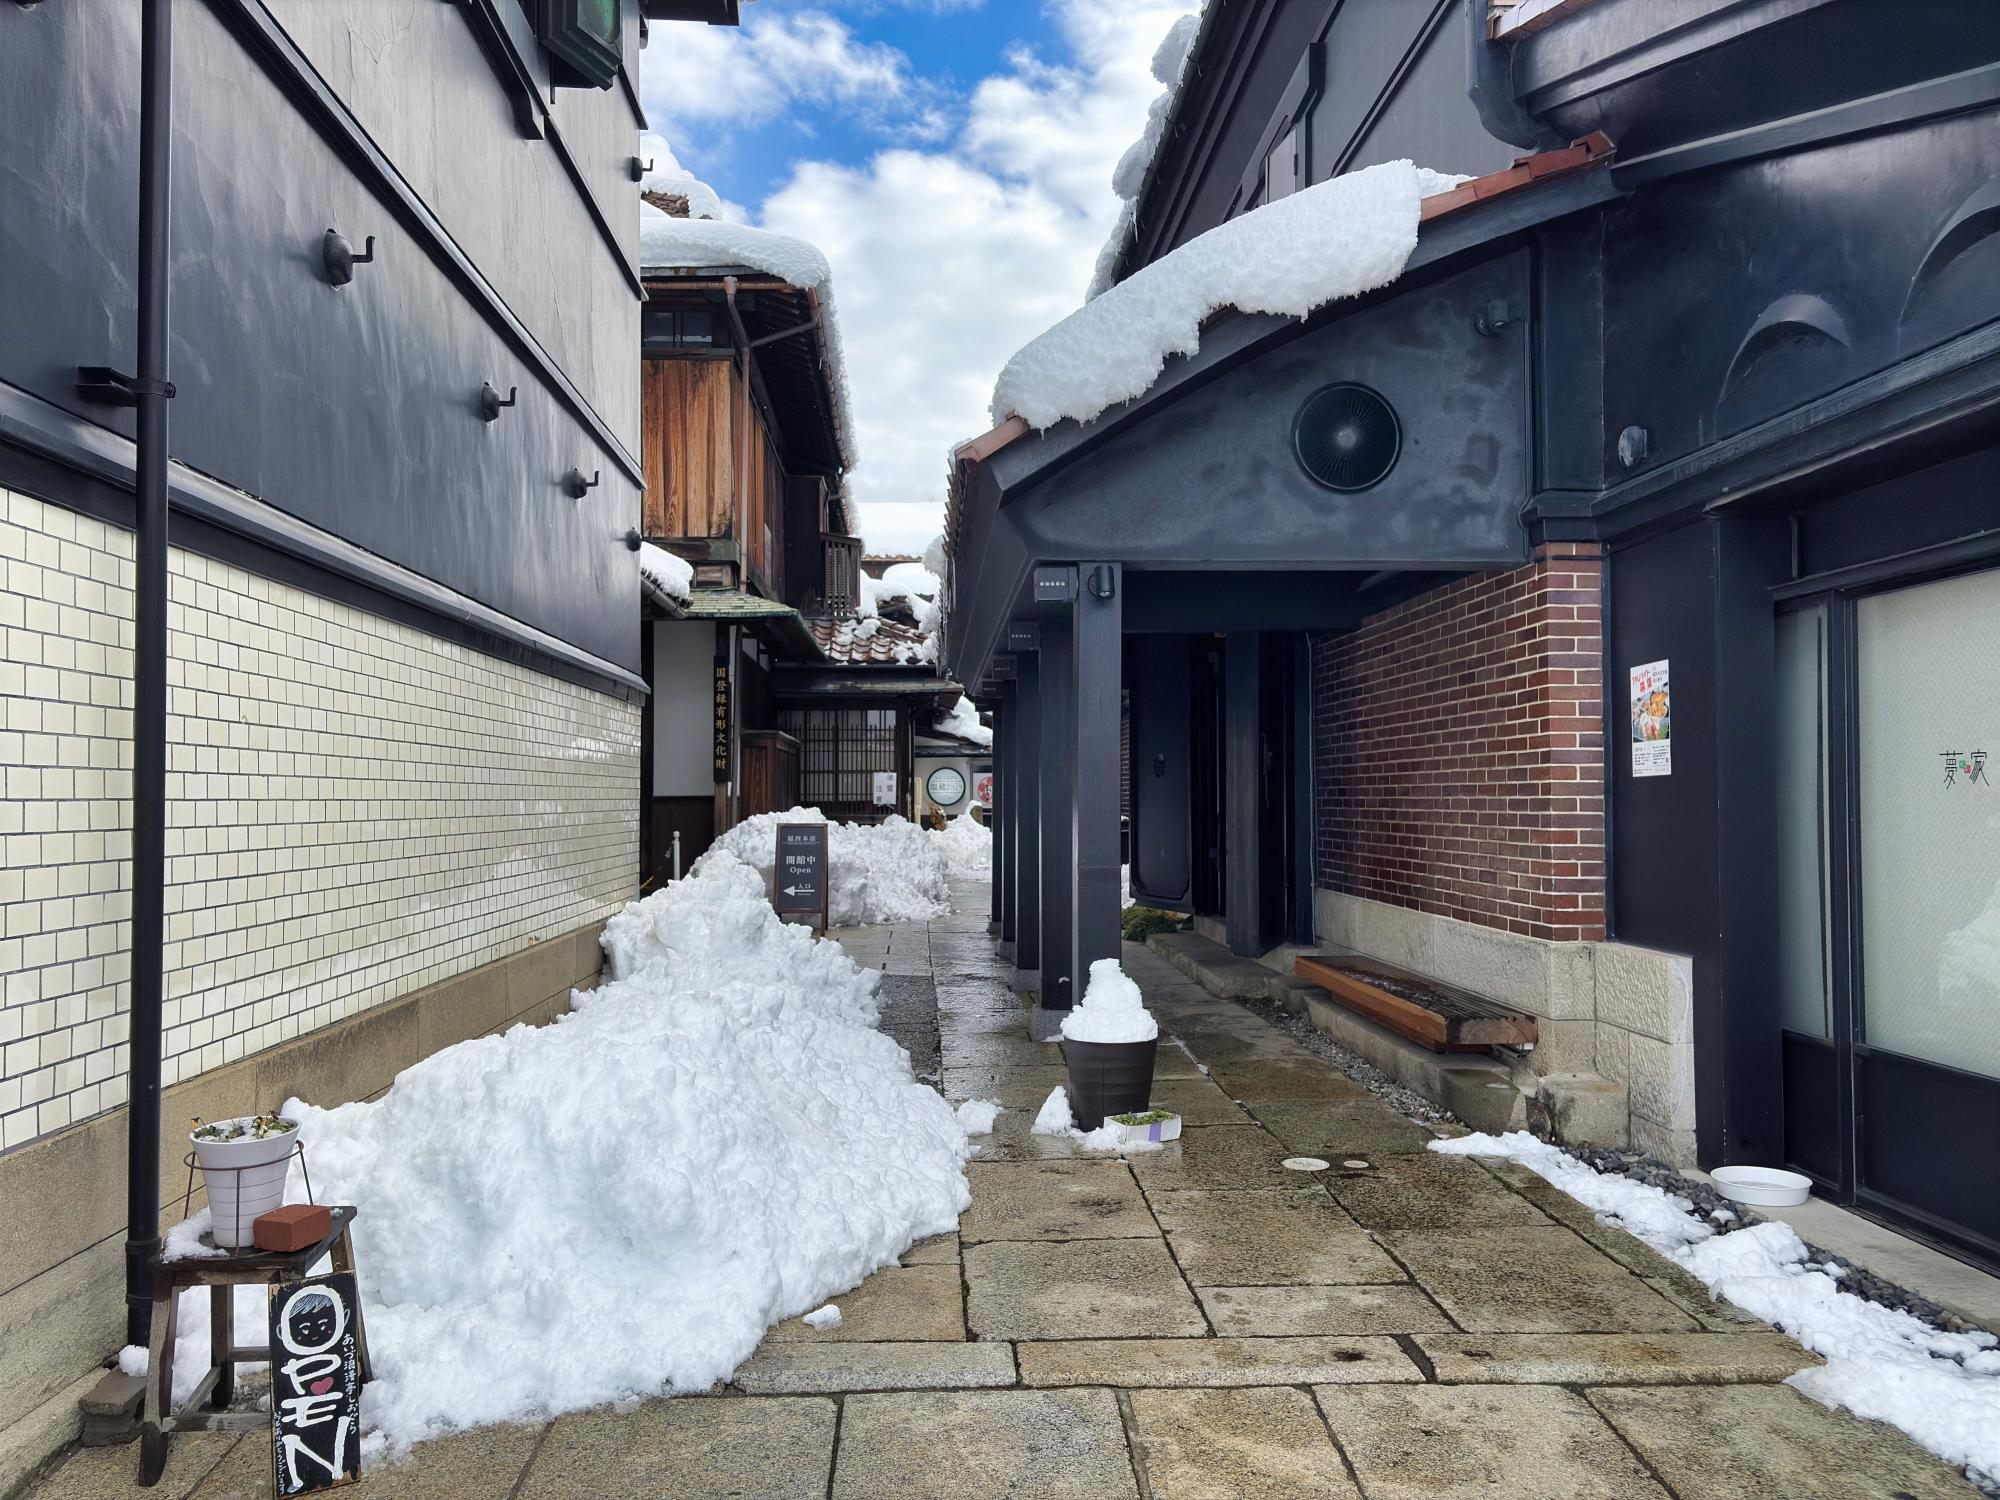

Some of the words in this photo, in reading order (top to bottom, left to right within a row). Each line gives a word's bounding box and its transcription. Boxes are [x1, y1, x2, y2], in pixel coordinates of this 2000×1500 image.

[715, 667, 727, 770] 国登録有形文化財
[785, 856, 816, 865] 開館中
[789, 866, 811, 875] Open
[280, 1285, 350, 1492] OPEN
